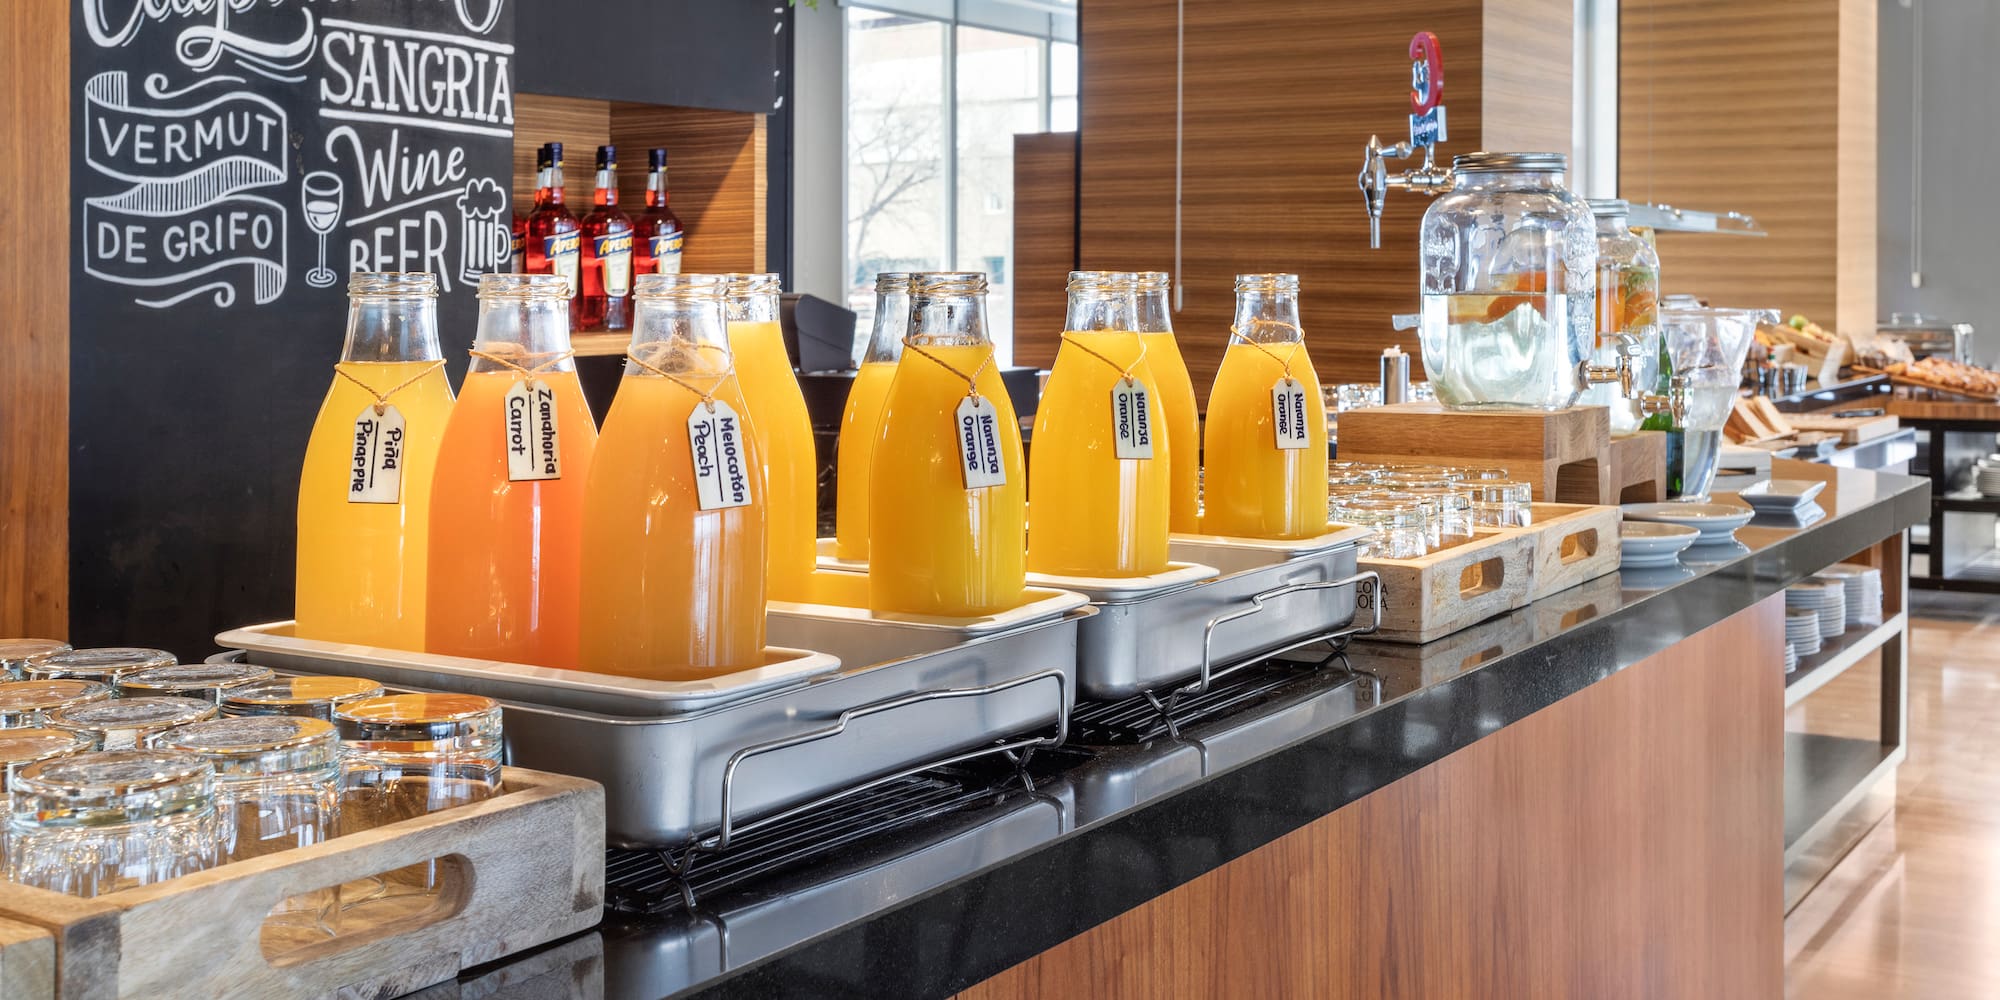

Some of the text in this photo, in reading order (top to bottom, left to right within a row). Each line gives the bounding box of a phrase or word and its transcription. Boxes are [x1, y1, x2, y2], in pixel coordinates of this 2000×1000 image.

[320, 31, 514, 125] SANGRIA
[98, 111, 277, 164] VERMUT
[325, 126, 466, 207] Wine
[98, 212, 273, 264] DE GRIFO
[350, 211, 451, 292] BEER
[510, 396, 526, 456] Carrot
[538, 388, 557, 474] Zanahoria
[1118, 393, 1130, 440] Orange
[1277, 393, 1288, 435] Orange
[381, 427, 402, 470] Piña
[694, 420, 714, 477] Peach
[720, 417, 745, 503] Melocotón
[963, 416, 978, 471] Orange
